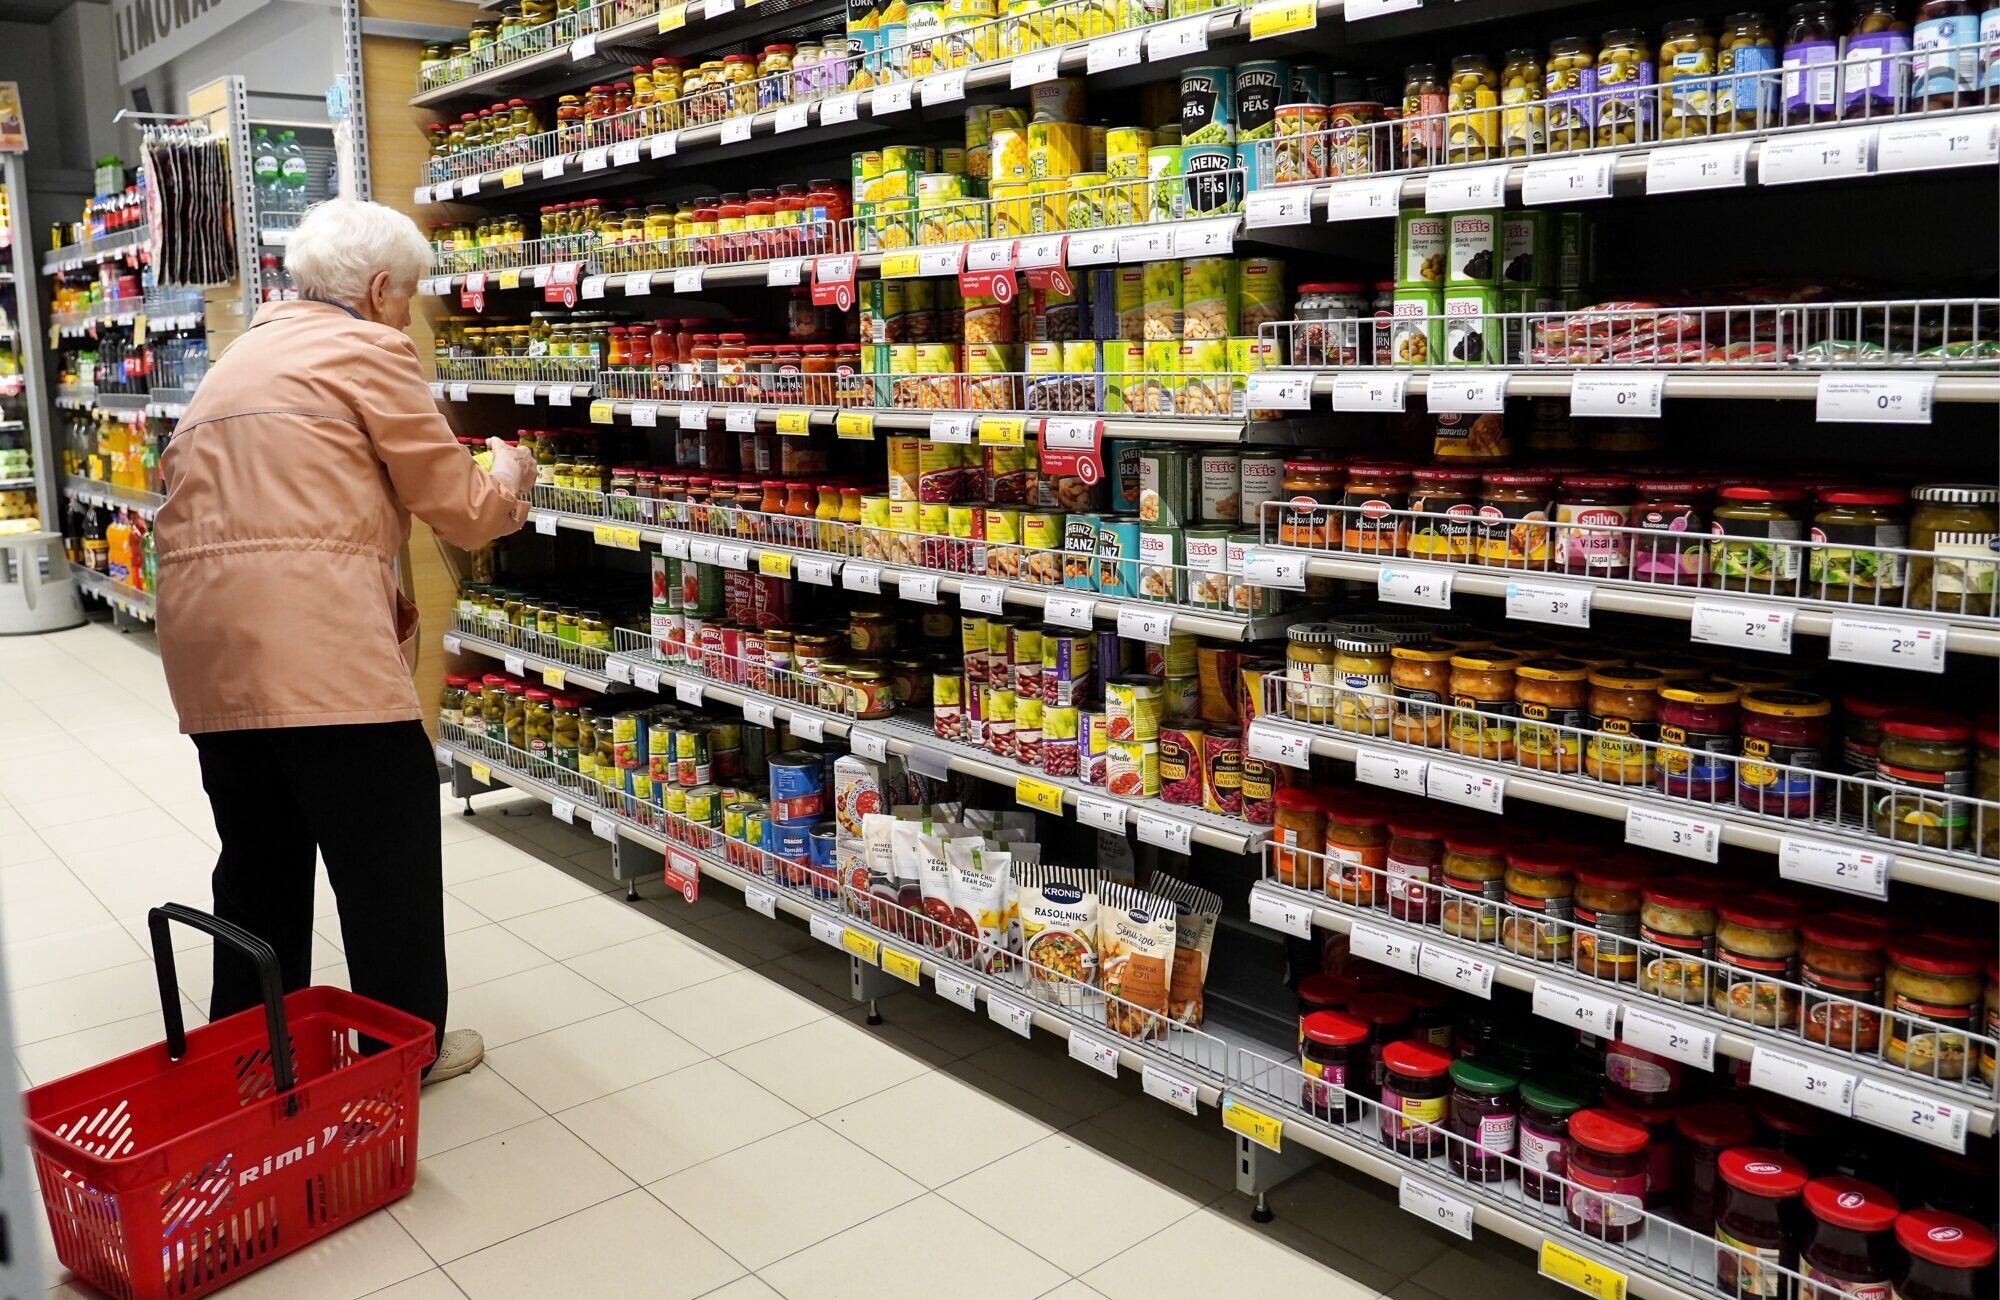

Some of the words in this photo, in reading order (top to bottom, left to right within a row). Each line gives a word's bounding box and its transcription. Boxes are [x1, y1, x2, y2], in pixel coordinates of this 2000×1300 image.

[1182, 80, 1210, 92] HEINZ
[1239, 72, 1274, 88] HEINZ
[1183, 105, 1205, 118] PEAS
[1242, 99, 1269, 112] PEAS
[1191, 155, 1229, 170] HEINZ
[1412, 222, 1444, 235] Basic
[1455, 220, 1489, 233] Basic
[1448, 302, 1478, 315] Basic
[1204, 461, 1236, 473] Basic
[1244, 465, 1275, 476] Basic
[1582, 515, 1618, 527] spilva
[1067, 523, 1091, 535] HEINZ
[1065, 538, 1094, 550] BEANZ
[1188, 542, 1217, 555] Basic
[1591, 555, 1608, 564] zupa
[1456, 698, 1474, 708] KOK
[1523, 707, 1544, 717] KOK
[1605, 722, 1627, 731] KOK
[1661, 727, 1682, 741] KOK
[1163, 744, 1176, 753] KOK
[1745, 740, 1766, 753] KOK
[1247, 764, 1261, 772] KOK
[959, 868, 979, 878] VEGAN
[962, 877, 974, 885] BEAN
[976, 880, 992, 888] SOUP
[1044, 886, 1081, 899] KRONIS
[1130, 912, 1149, 921] KRONIS
[1486, 1119, 1514, 1132] Basic
[238, 1137, 316, 1186] Rimi
